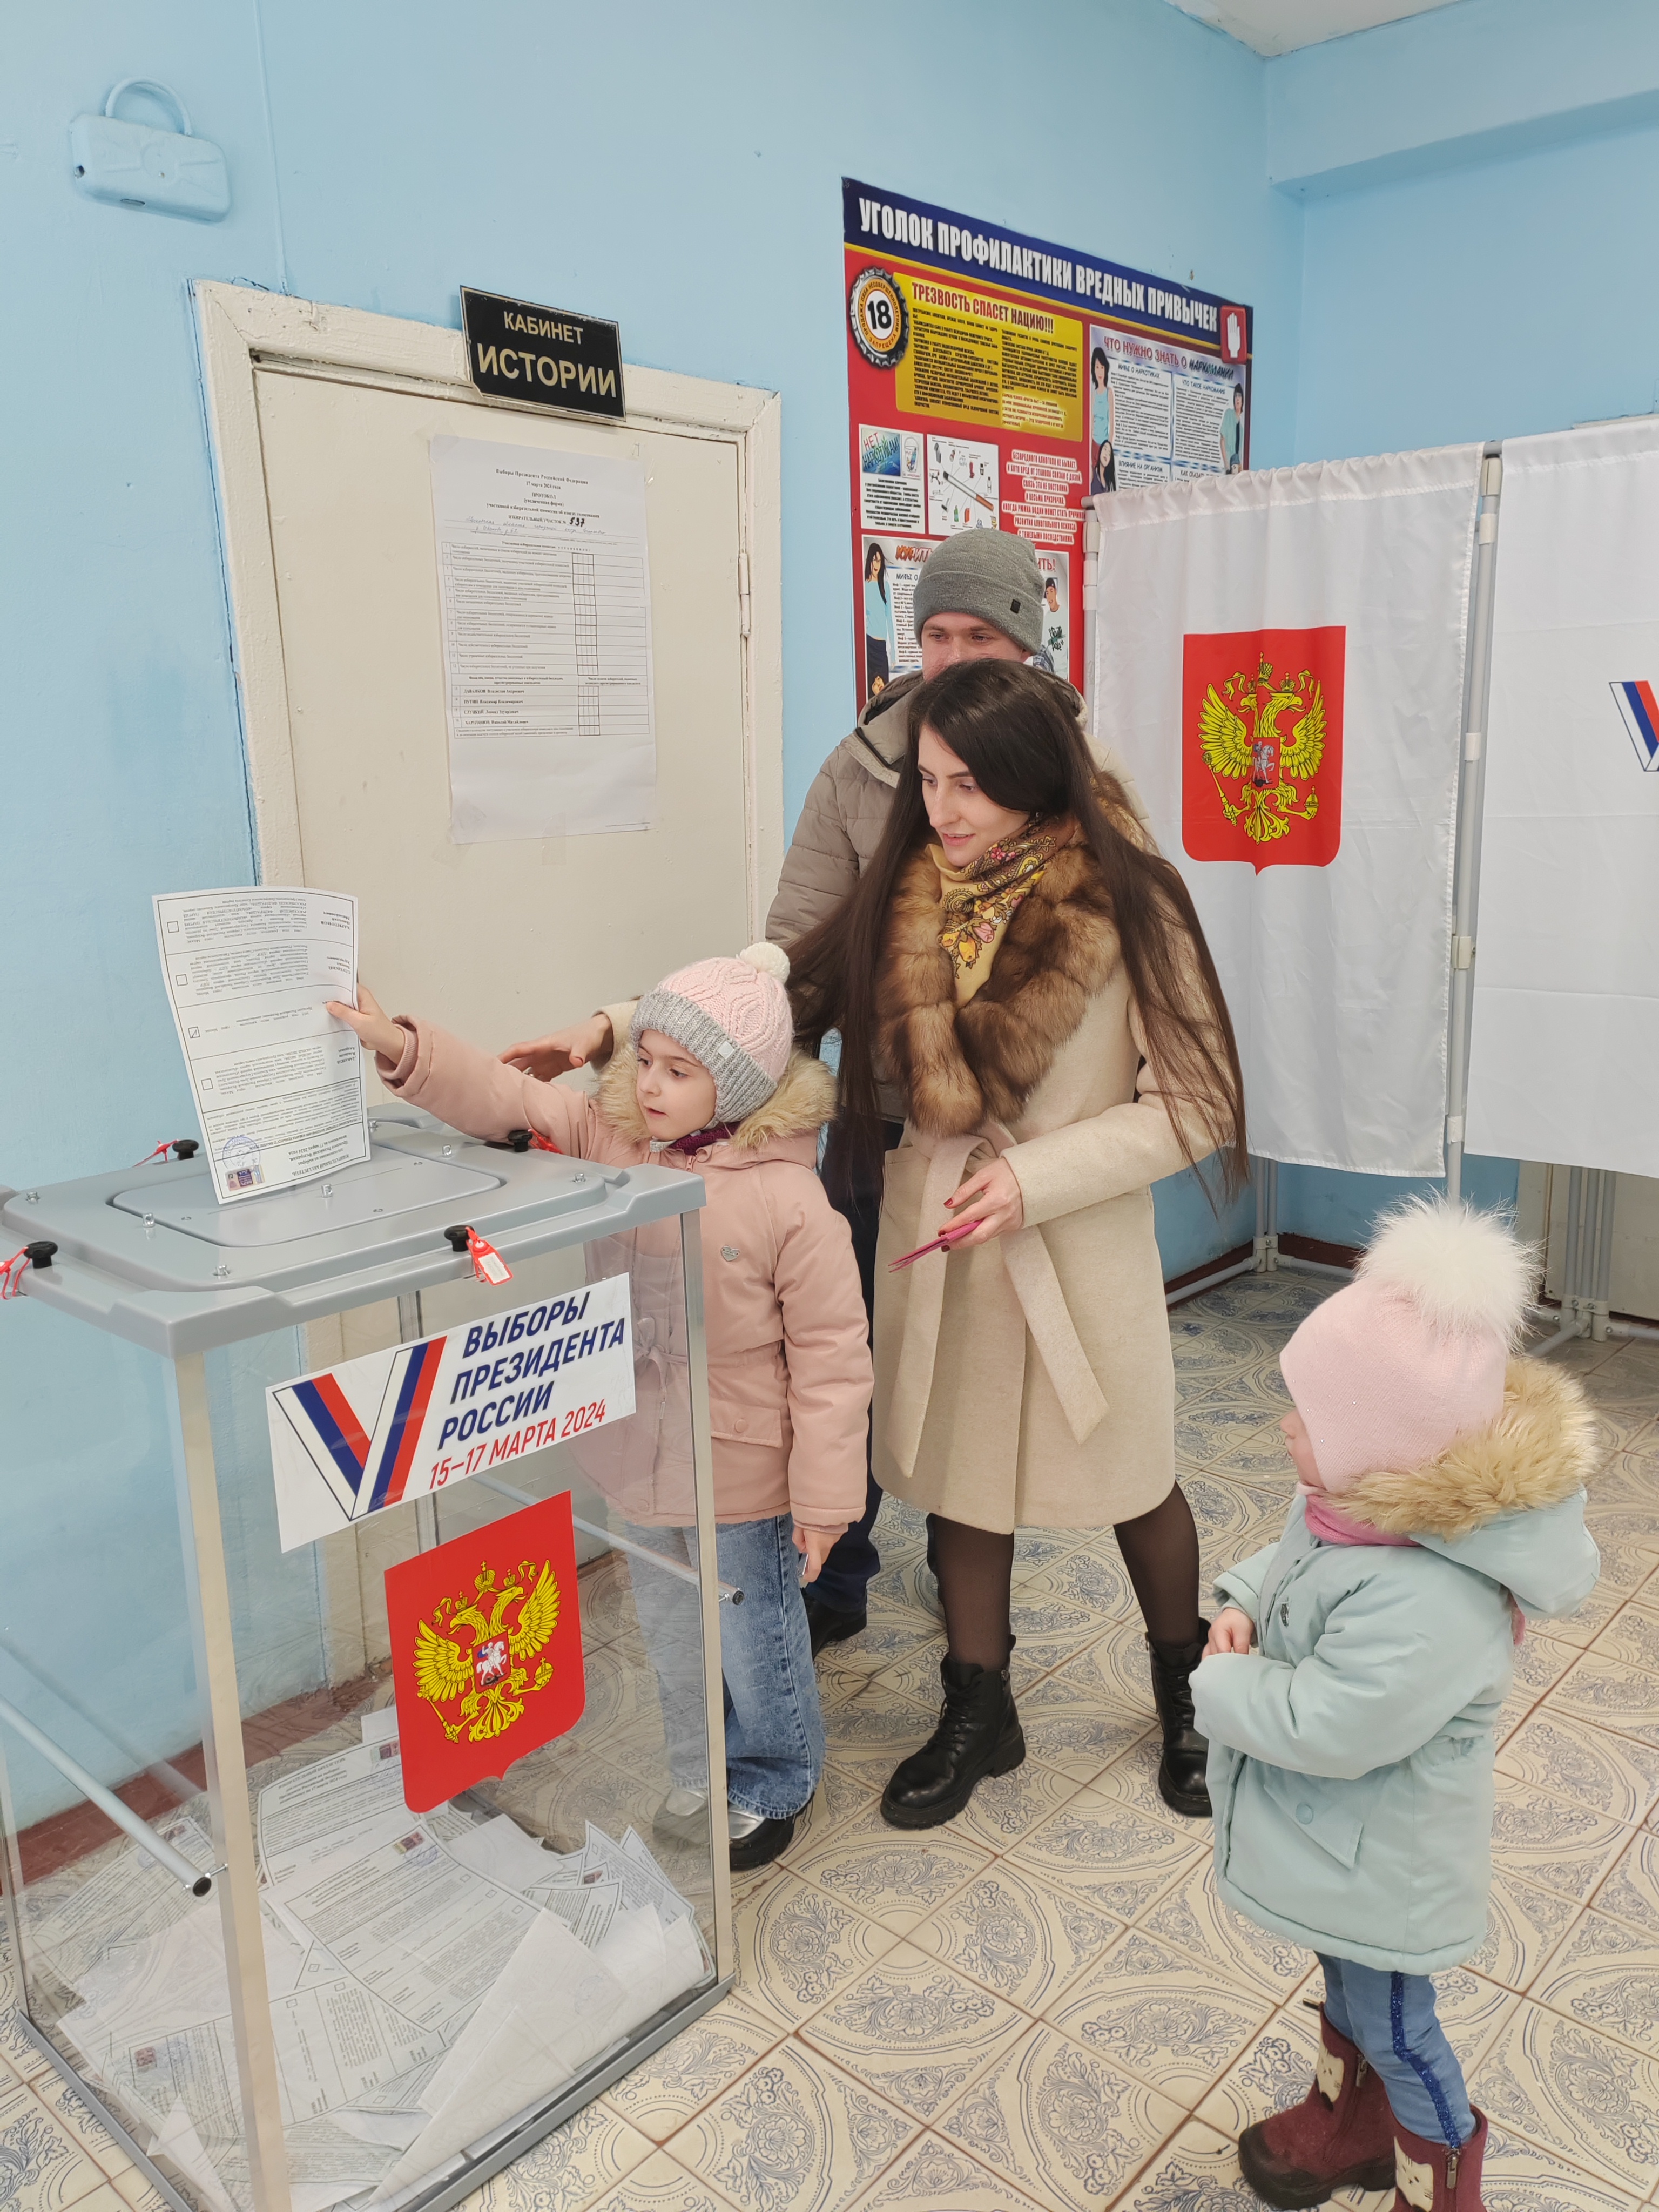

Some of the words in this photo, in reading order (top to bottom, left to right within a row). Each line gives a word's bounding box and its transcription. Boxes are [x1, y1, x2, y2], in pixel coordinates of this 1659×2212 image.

[859, 197, 933, 249] УГОЛОК
[938, 221, 1071, 288] ПРОФИЛАКТИКИ
[1075, 265, 1147, 312] ВРЕДНЫХ
[1148, 286, 1217, 332] ПРИВЫЧЕК
[860, 303, 868, 335] ПРОДАЖА
[868, 300, 892, 329] 18
[912, 282, 970, 313] ТРЕЗВОСТЬ
[973, 296, 1009, 322] СПАСЕТ
[1011, 308, 1054, 333] НАЦИЮ!!!
[504, 311, 583, 344] КАБИНЕТ
[869, 335, 896, 349] ЗАПРЕЩЕНА
[477, 343, 616, 397] ИСТОРИИ
[1104, 336, 1121, 351] ЧТО
[1123, 343, 1152, 359] НУЖНО
[1155, 349, 1179, 366] ЗНАТЬ
[1181, 356, 1187, 368] О
[1189, 359, 1234, 381] НАРКОМАНИИ
[1135, 367, 1160, 378] НАРКОТИКАХ
[864, 432, 881, 451] НЕТ
[515, 471, 539, 479] Президента
[1011, 464, 1020, 473] ХОТЯ
[1021, 466, 1029, 475] ВРЕД
[1057, 458, 1061, 466] НЕ
[1118, 460, 1136, 469] ВЛИЯНИЕ
[1143, 464, 1163, 473] ОРГАНИЗМ
[321, 921, 350, 930] ХАРИТОНОВ
[462, 1291, 591, 1359] ВЫБОРЫ
[450, 1318, 625, 1404] ПРЕЗИДЕНТА
[437, 1381, 555, 1450] РОССИИ
[489, 1418, 556, 1466] МАРТА
[561, 1399, 606, 1439] 2024
